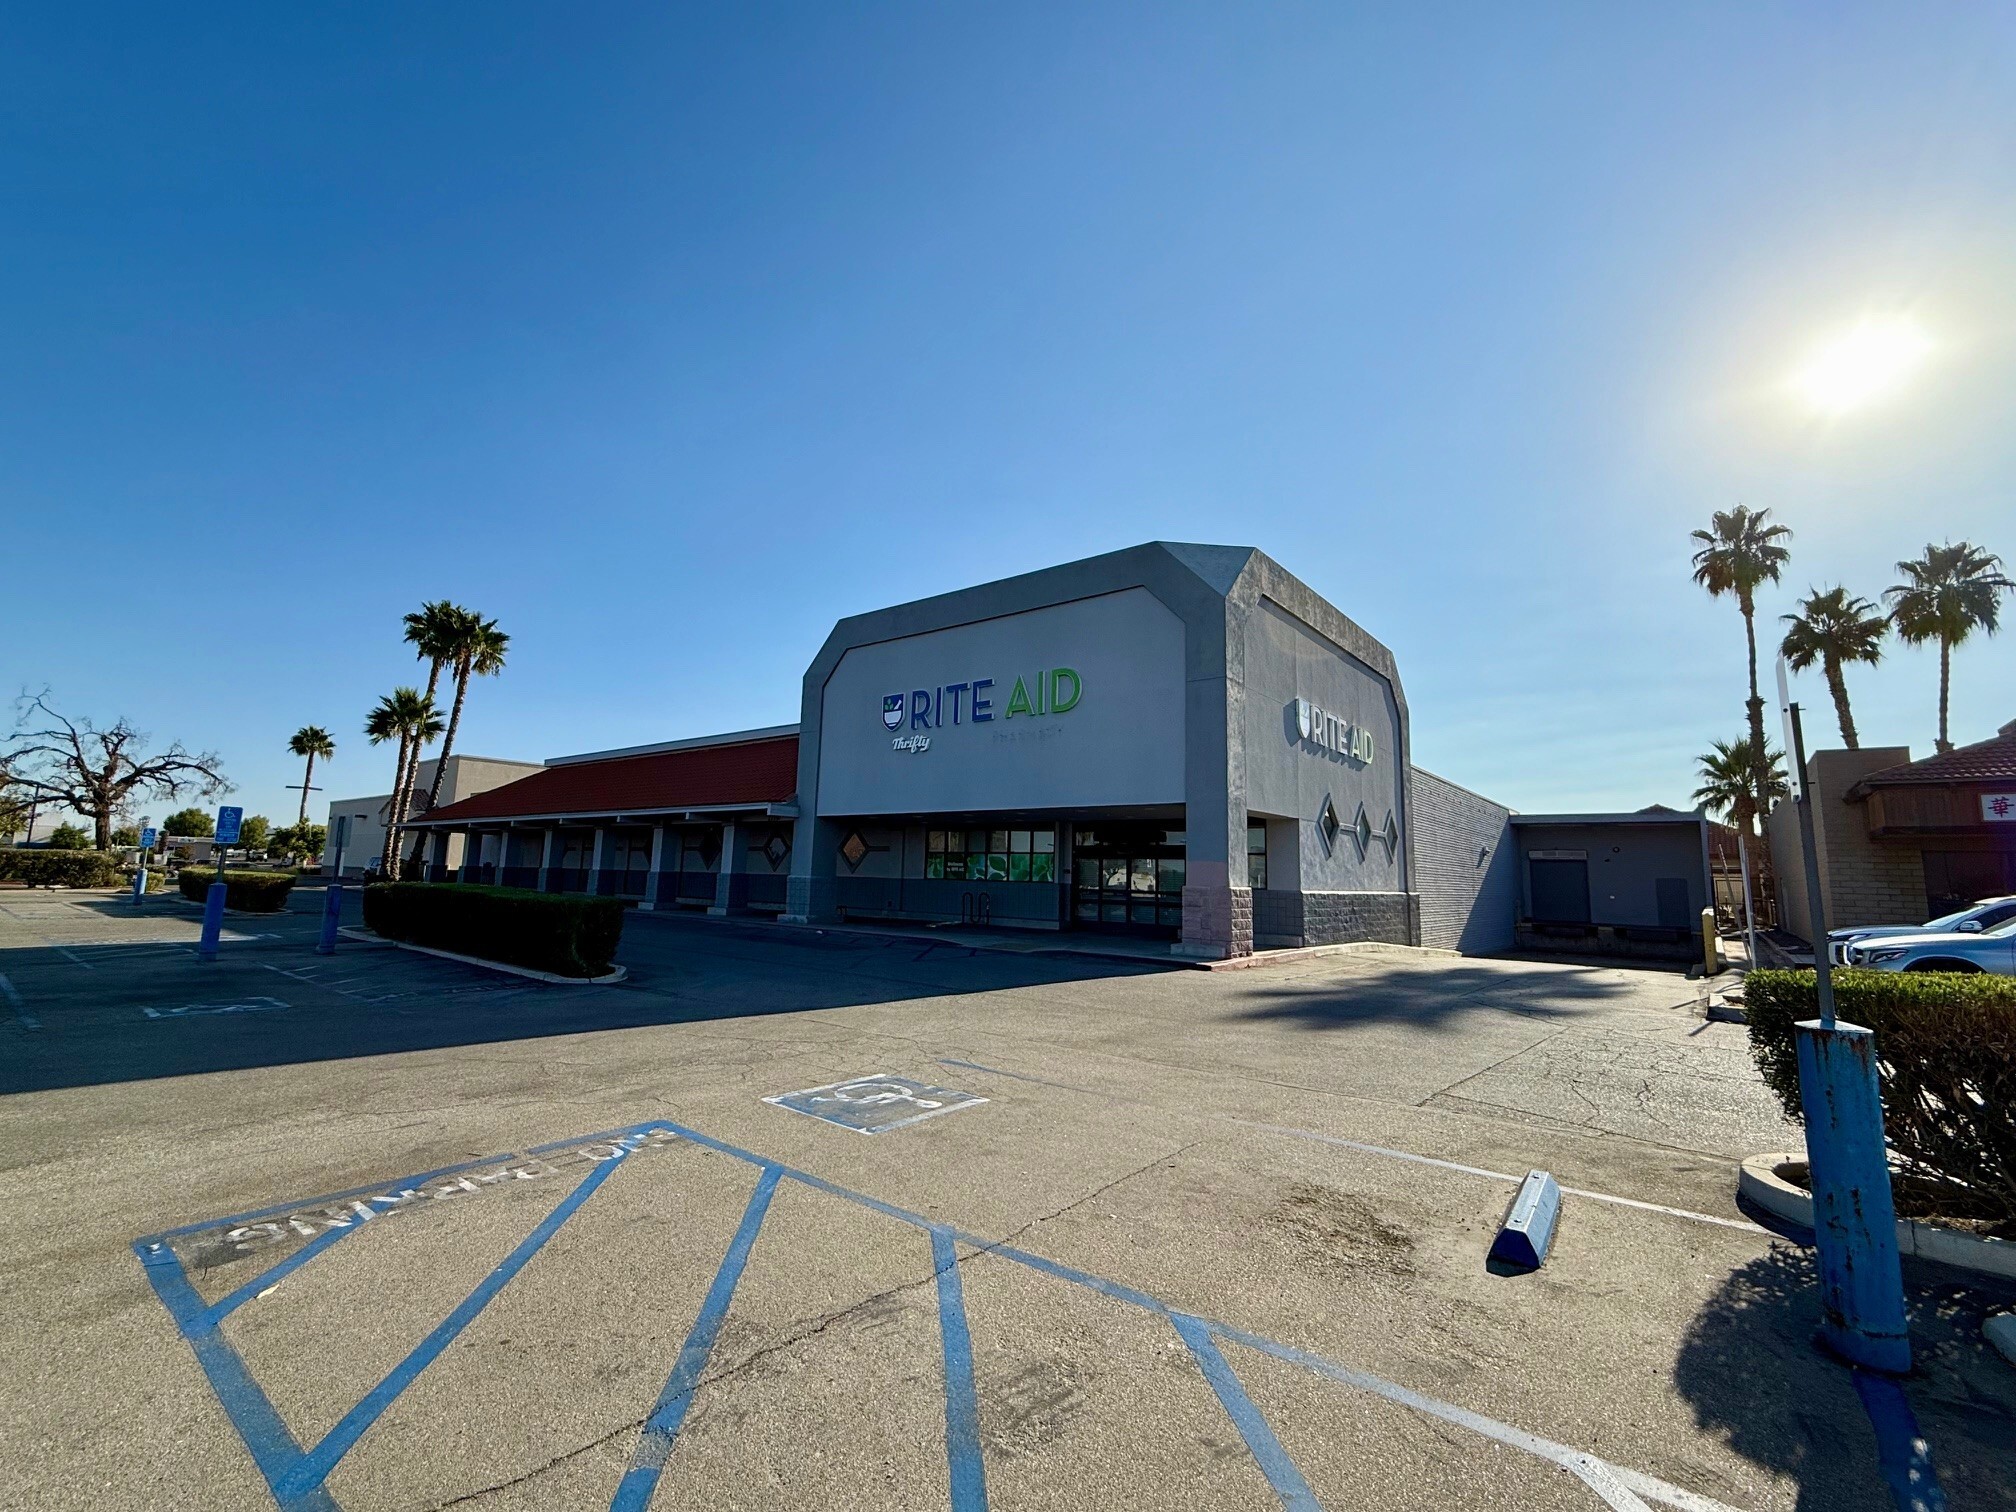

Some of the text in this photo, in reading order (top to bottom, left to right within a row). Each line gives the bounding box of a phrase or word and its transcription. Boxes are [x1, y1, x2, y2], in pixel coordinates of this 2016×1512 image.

[910, 667, 1082, 730] RITE AID
[892, 735, 930, 753] Thrifty
[1311, 704, 1374, 764] RITE AID
[1988, 796, 2015, 818] 華
